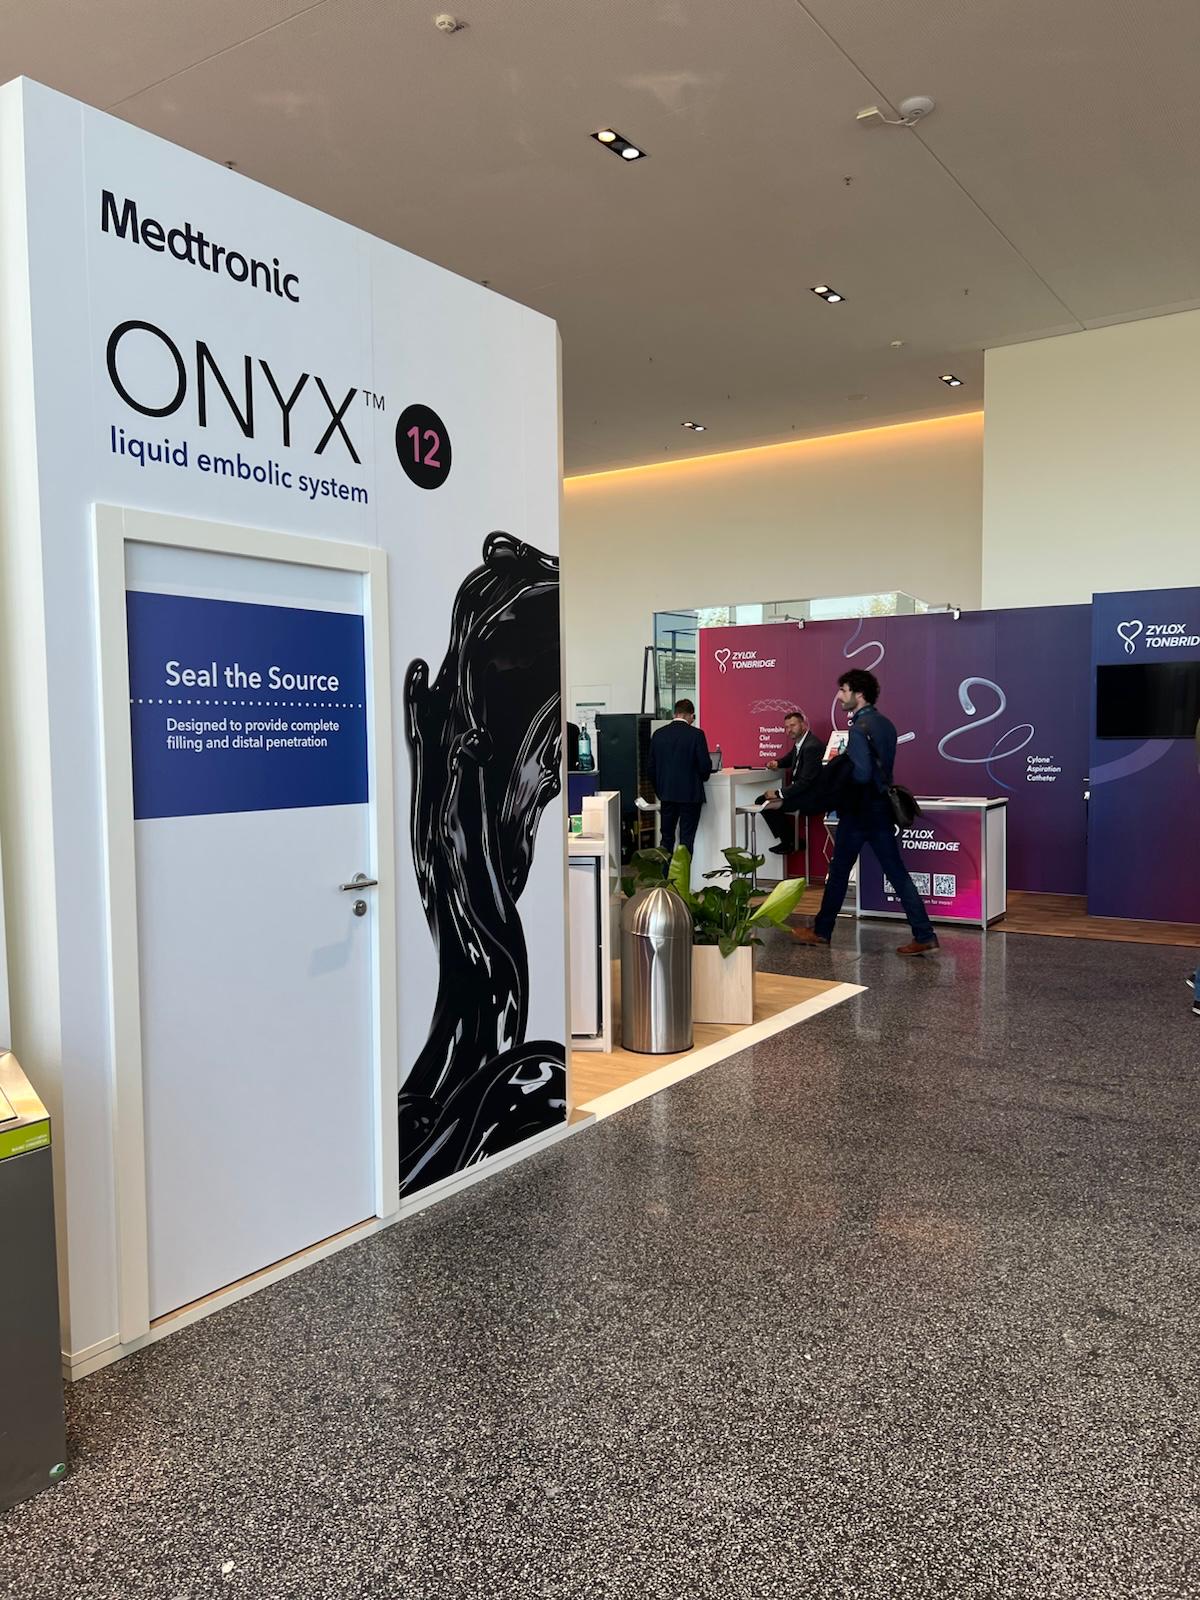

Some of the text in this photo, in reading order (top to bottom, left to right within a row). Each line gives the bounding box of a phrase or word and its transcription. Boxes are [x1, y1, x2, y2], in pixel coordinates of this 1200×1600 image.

[101, 189, 300, 303] Medtronic
[406, 425, 442, 469] 12
[110, 425, 369, 505] liquid embolic system
[1145, 623, 1187, 636] ZYLOX
[732, 651, 757, 660] ZYLOX
[732, 659, 776, 669] TONBRIDGE
[165, 660, 340, 692] Seal the Source
[166, 718, 340, 735] Designed to provide complete
[166, 735, 328, 753] filling and distal penetration
[1026, 764, 1061, 773] Aspiration
[1026, 774, 1056, 782] Catheter
[902, 829, 934, 839] ZYLOX
[902, 840, 960, 851] TONBRIDGE
